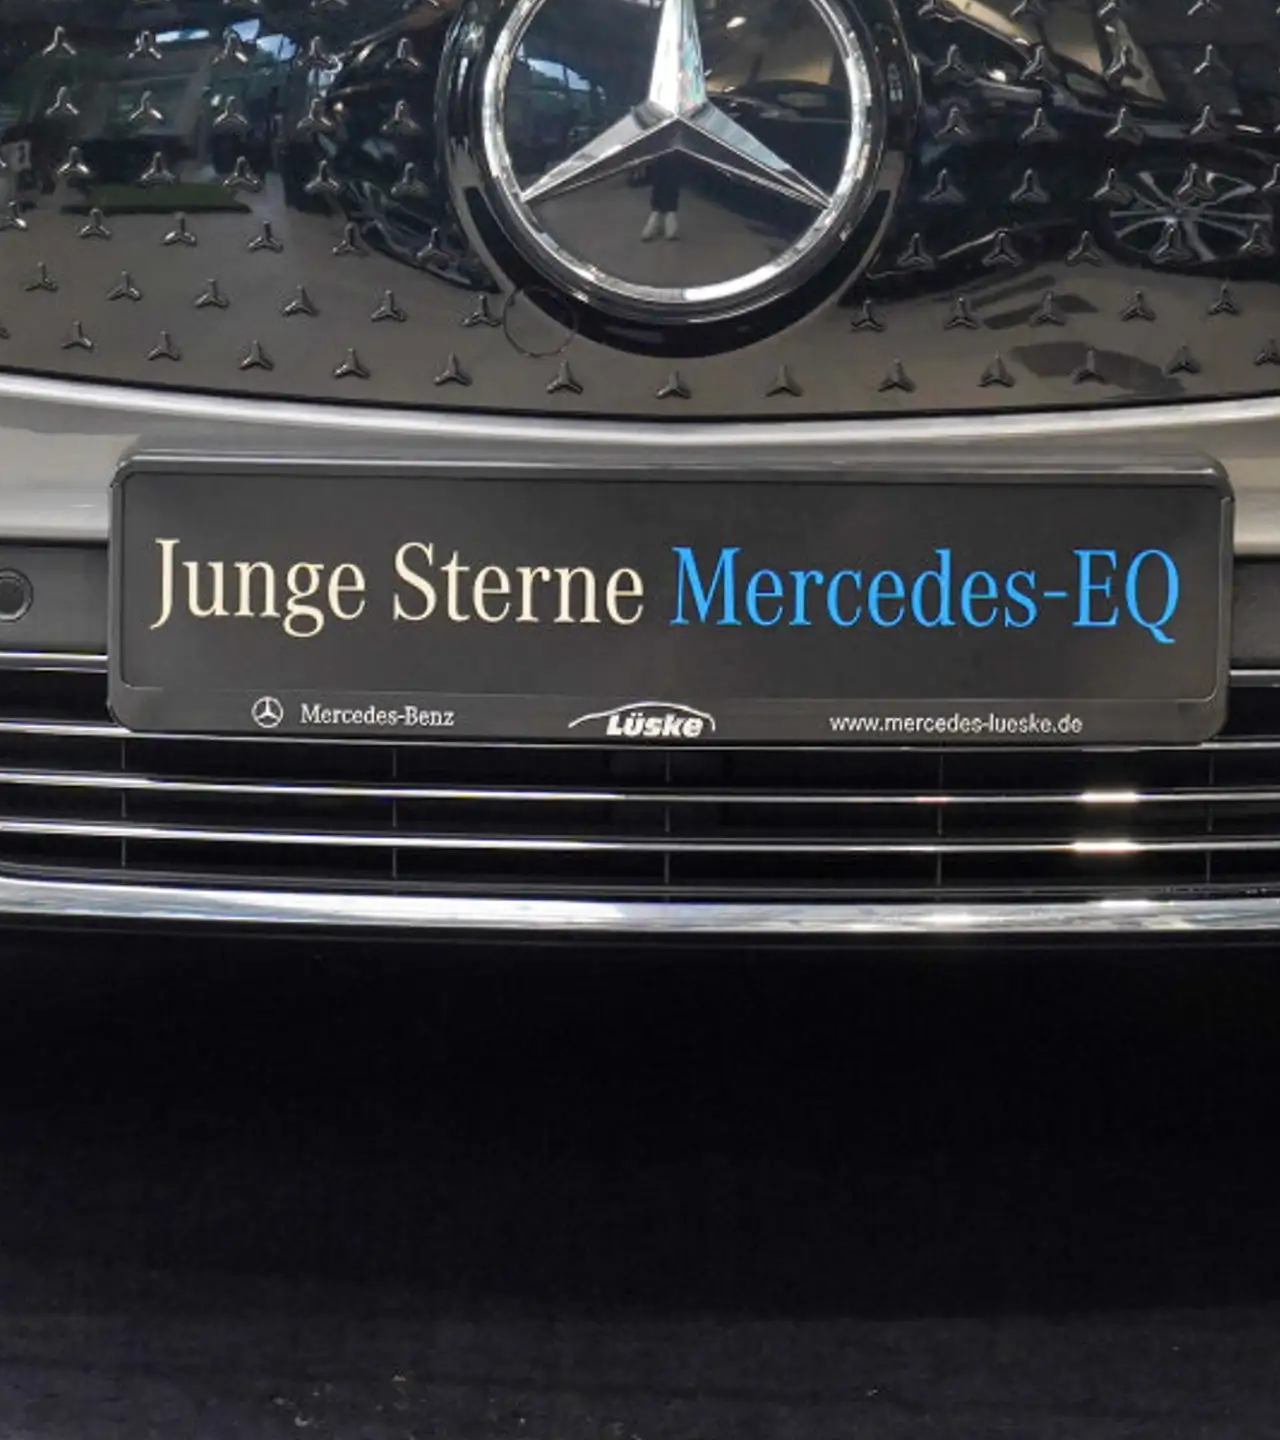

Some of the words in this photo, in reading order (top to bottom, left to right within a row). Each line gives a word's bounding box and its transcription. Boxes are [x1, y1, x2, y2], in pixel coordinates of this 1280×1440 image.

[149, 537, 366, 638] Junge
[392, 541, 645, 625] Sterne
[669, 546, 1180, 644] Mercedes-EQ
[300, 703, 455, 727] Mercedes-Benz
[605, 712, 705, 738] Lüske
[829, 712, 1083, 734] www.mercedes-lueske.de
